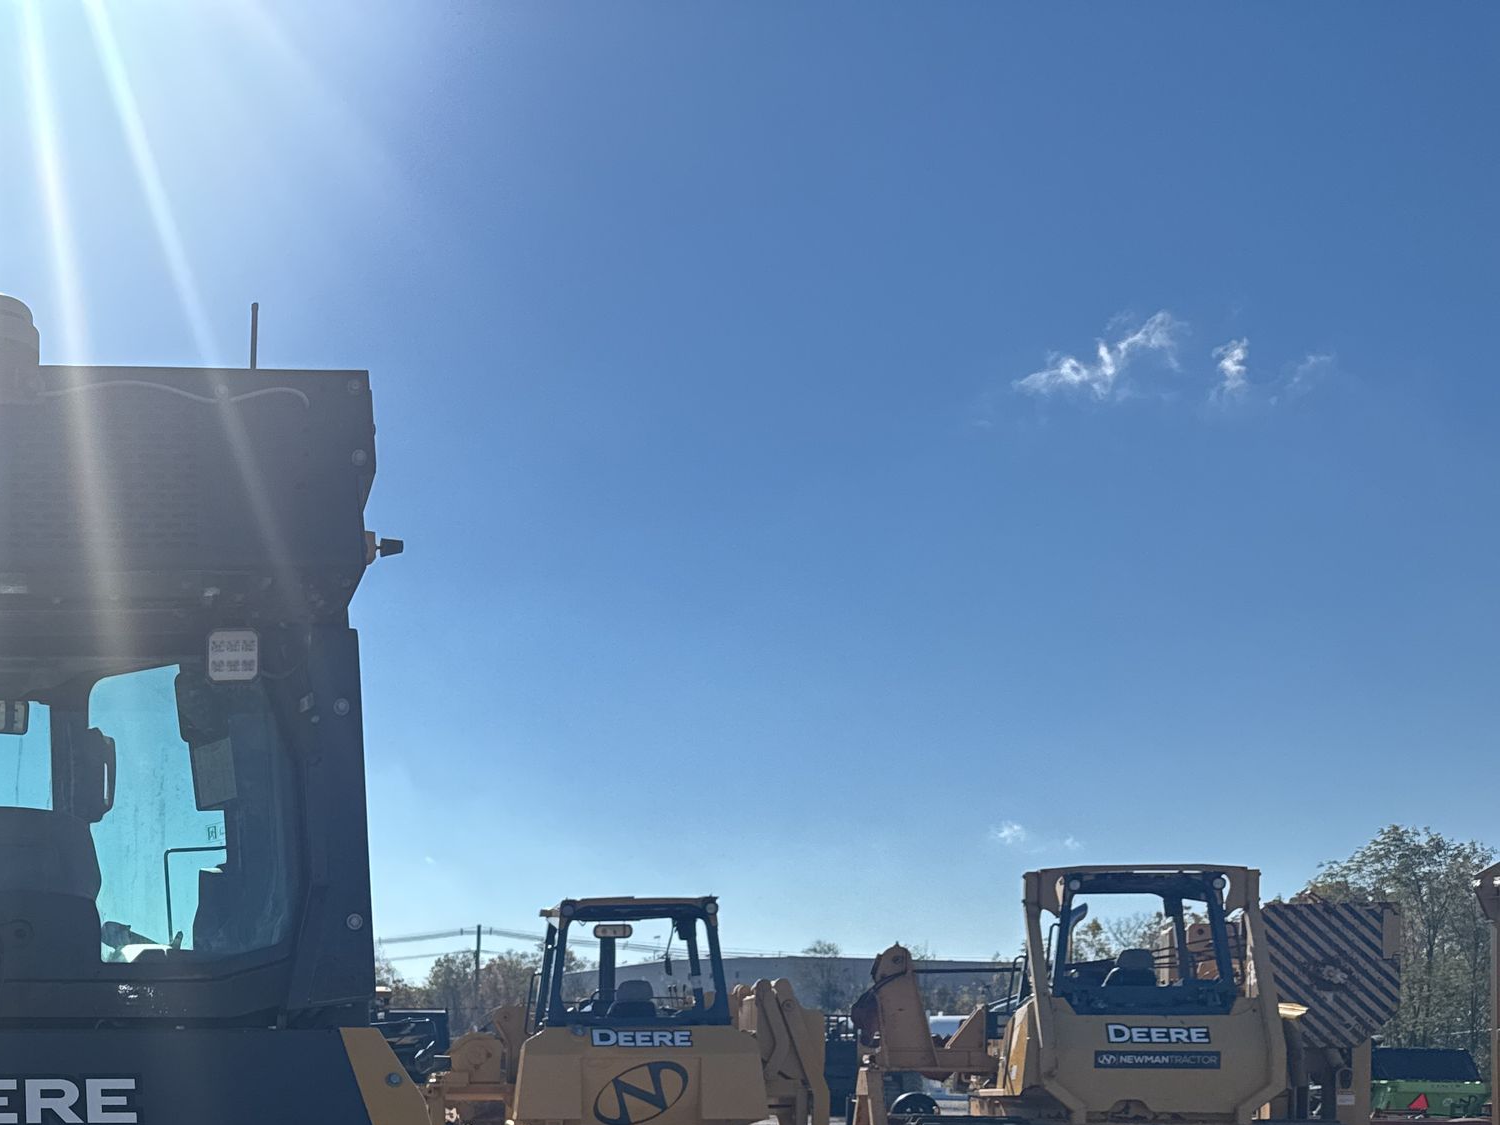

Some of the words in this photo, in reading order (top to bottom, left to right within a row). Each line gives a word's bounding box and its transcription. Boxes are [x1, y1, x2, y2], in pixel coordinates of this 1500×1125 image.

[591, 1028, 692, 1047] DEERE
[1107, 1023, 1210, 1043] DEERE
[1119, 1054, 1218, 1066] NEWMANTRACTOR
